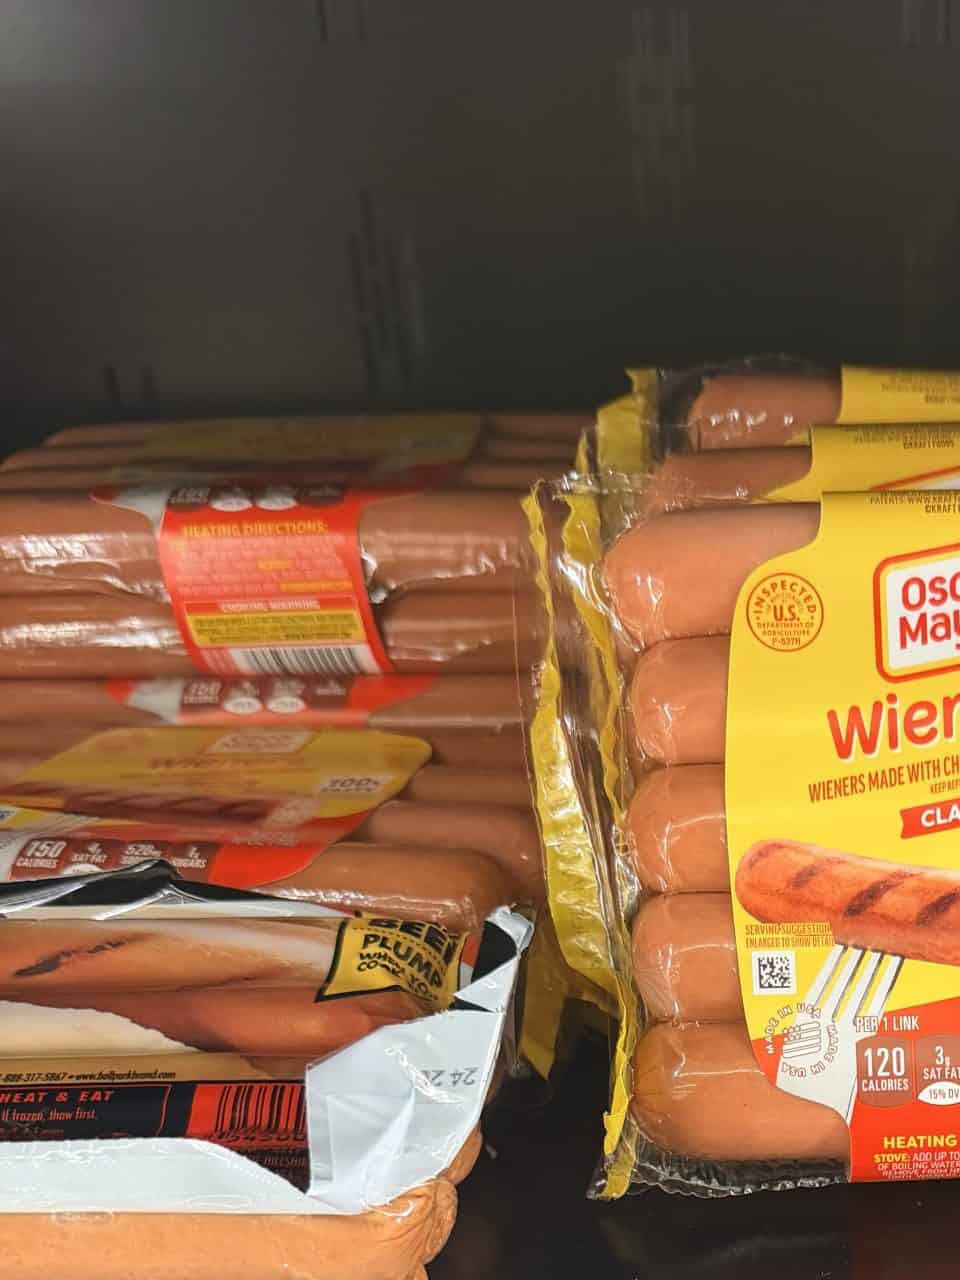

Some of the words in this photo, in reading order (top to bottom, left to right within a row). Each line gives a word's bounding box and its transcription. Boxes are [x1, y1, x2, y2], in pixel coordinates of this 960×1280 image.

[773, 605, 800, 622] U.S.
[808, 774, 867, 804] WIENERS
[867, 766, 906, 794] MADE
[907, 758, 942, 785] WITH
[25, 841, 66, 859] 150
[363, 933, 442, 988] PLUMP
[855, 1015, 879, 1033] PER
[883, 1016, 888, 1031] 1
[890, 1015, 919, 1031] LINK
[864, 1047, 905, 1077] 120
[935, 1046, 951, 1068] 3g
[923, 1067, 942, 1080] SAT
[861, 1078, 910, 1092] CALORIES
[0, 1090, 45, 1103] HEAT
[56, 1090, 69, 1102] &
[80, 1090, 114, 1101] EAT
[929, 1088, 946, 1100] 15%
[947, 1088, 960, 1100] DV
[49, 1107, 72, 1120] thaw
[883, 1134, 957, 1149] HEATING
[873, 1153, 911, 1163] STOVE:
[913, 1151, 932, 1162] ADD
[934, 1151, 947, 1161] UP
[949, 1151, 960, 1161] TO
